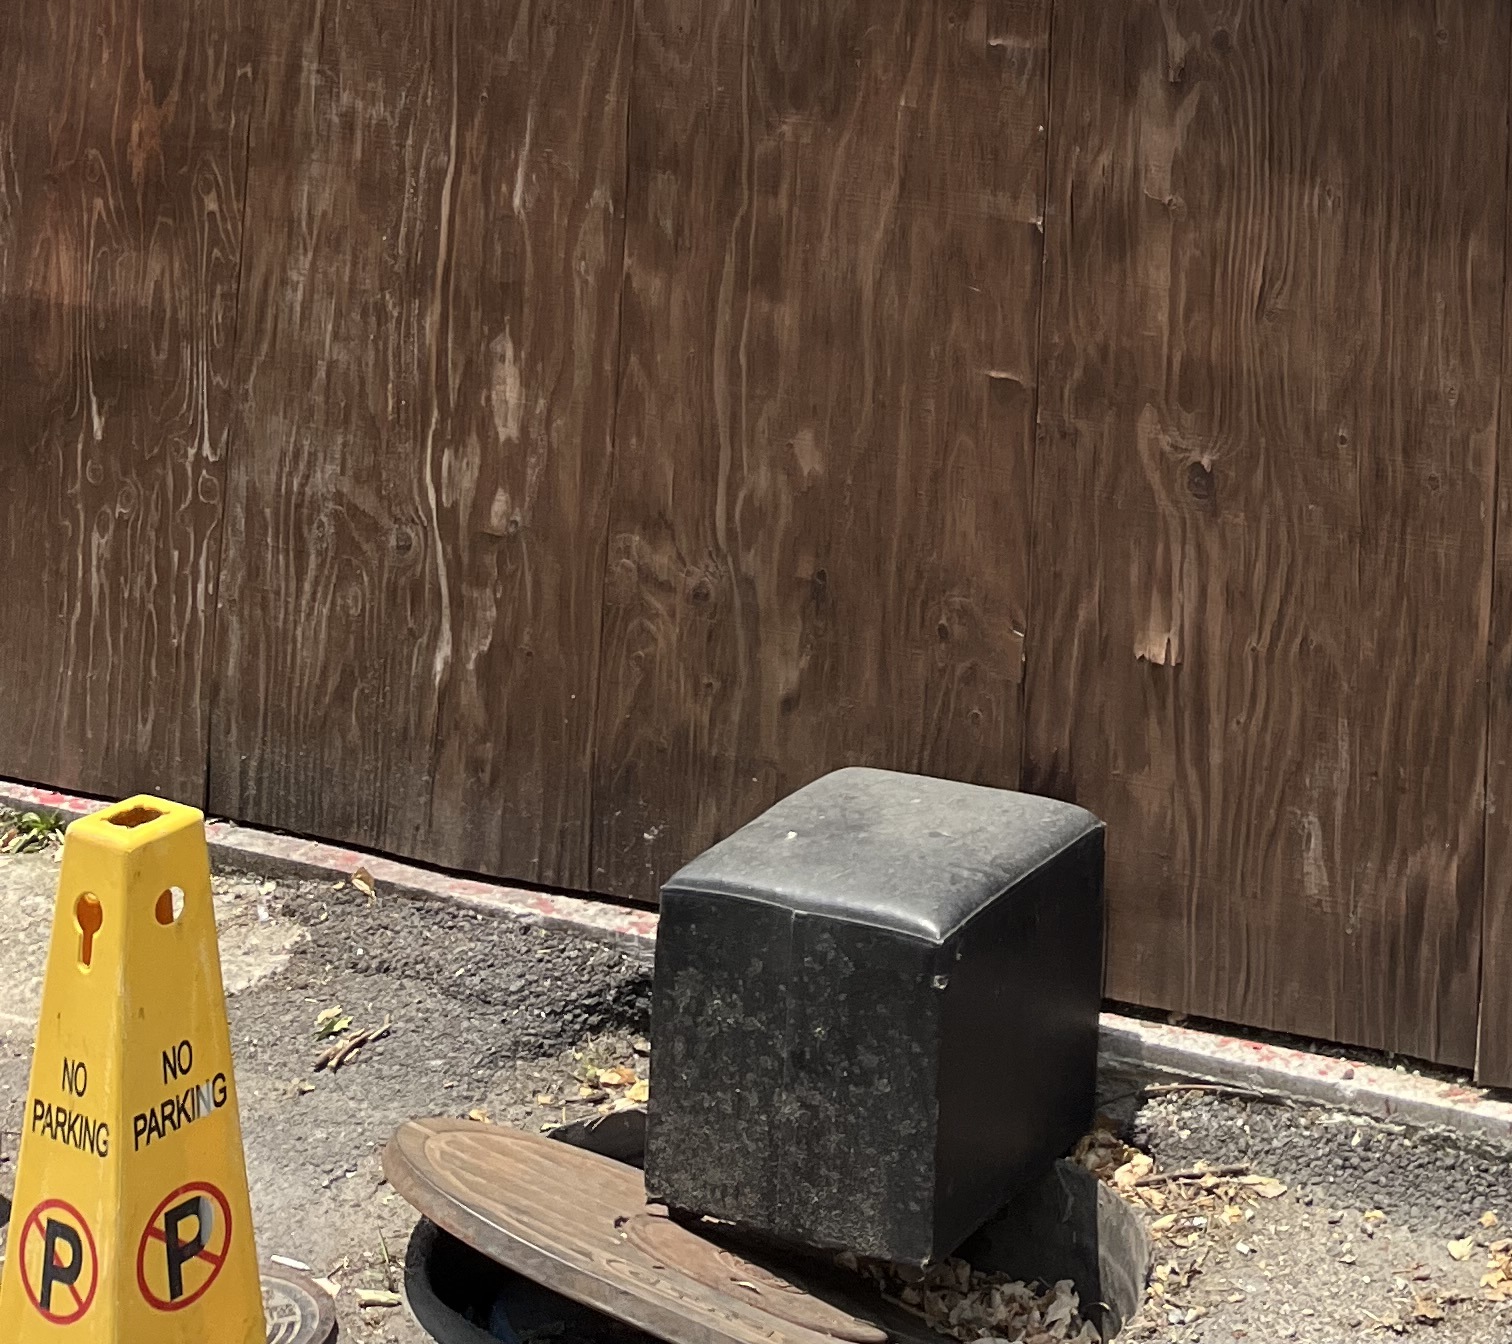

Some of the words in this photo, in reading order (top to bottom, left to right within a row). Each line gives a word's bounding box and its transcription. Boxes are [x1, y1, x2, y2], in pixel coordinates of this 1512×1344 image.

[62, 1057, 87, 1099] NO
[162, 1040, 193, 1085] NO
[32, 1098, 110, 1158] PARKING
[133, 1072, 227, 1152] PARKING
[41, 1218, 82, 1311] P
[164, 1195, 215, 1302] P
